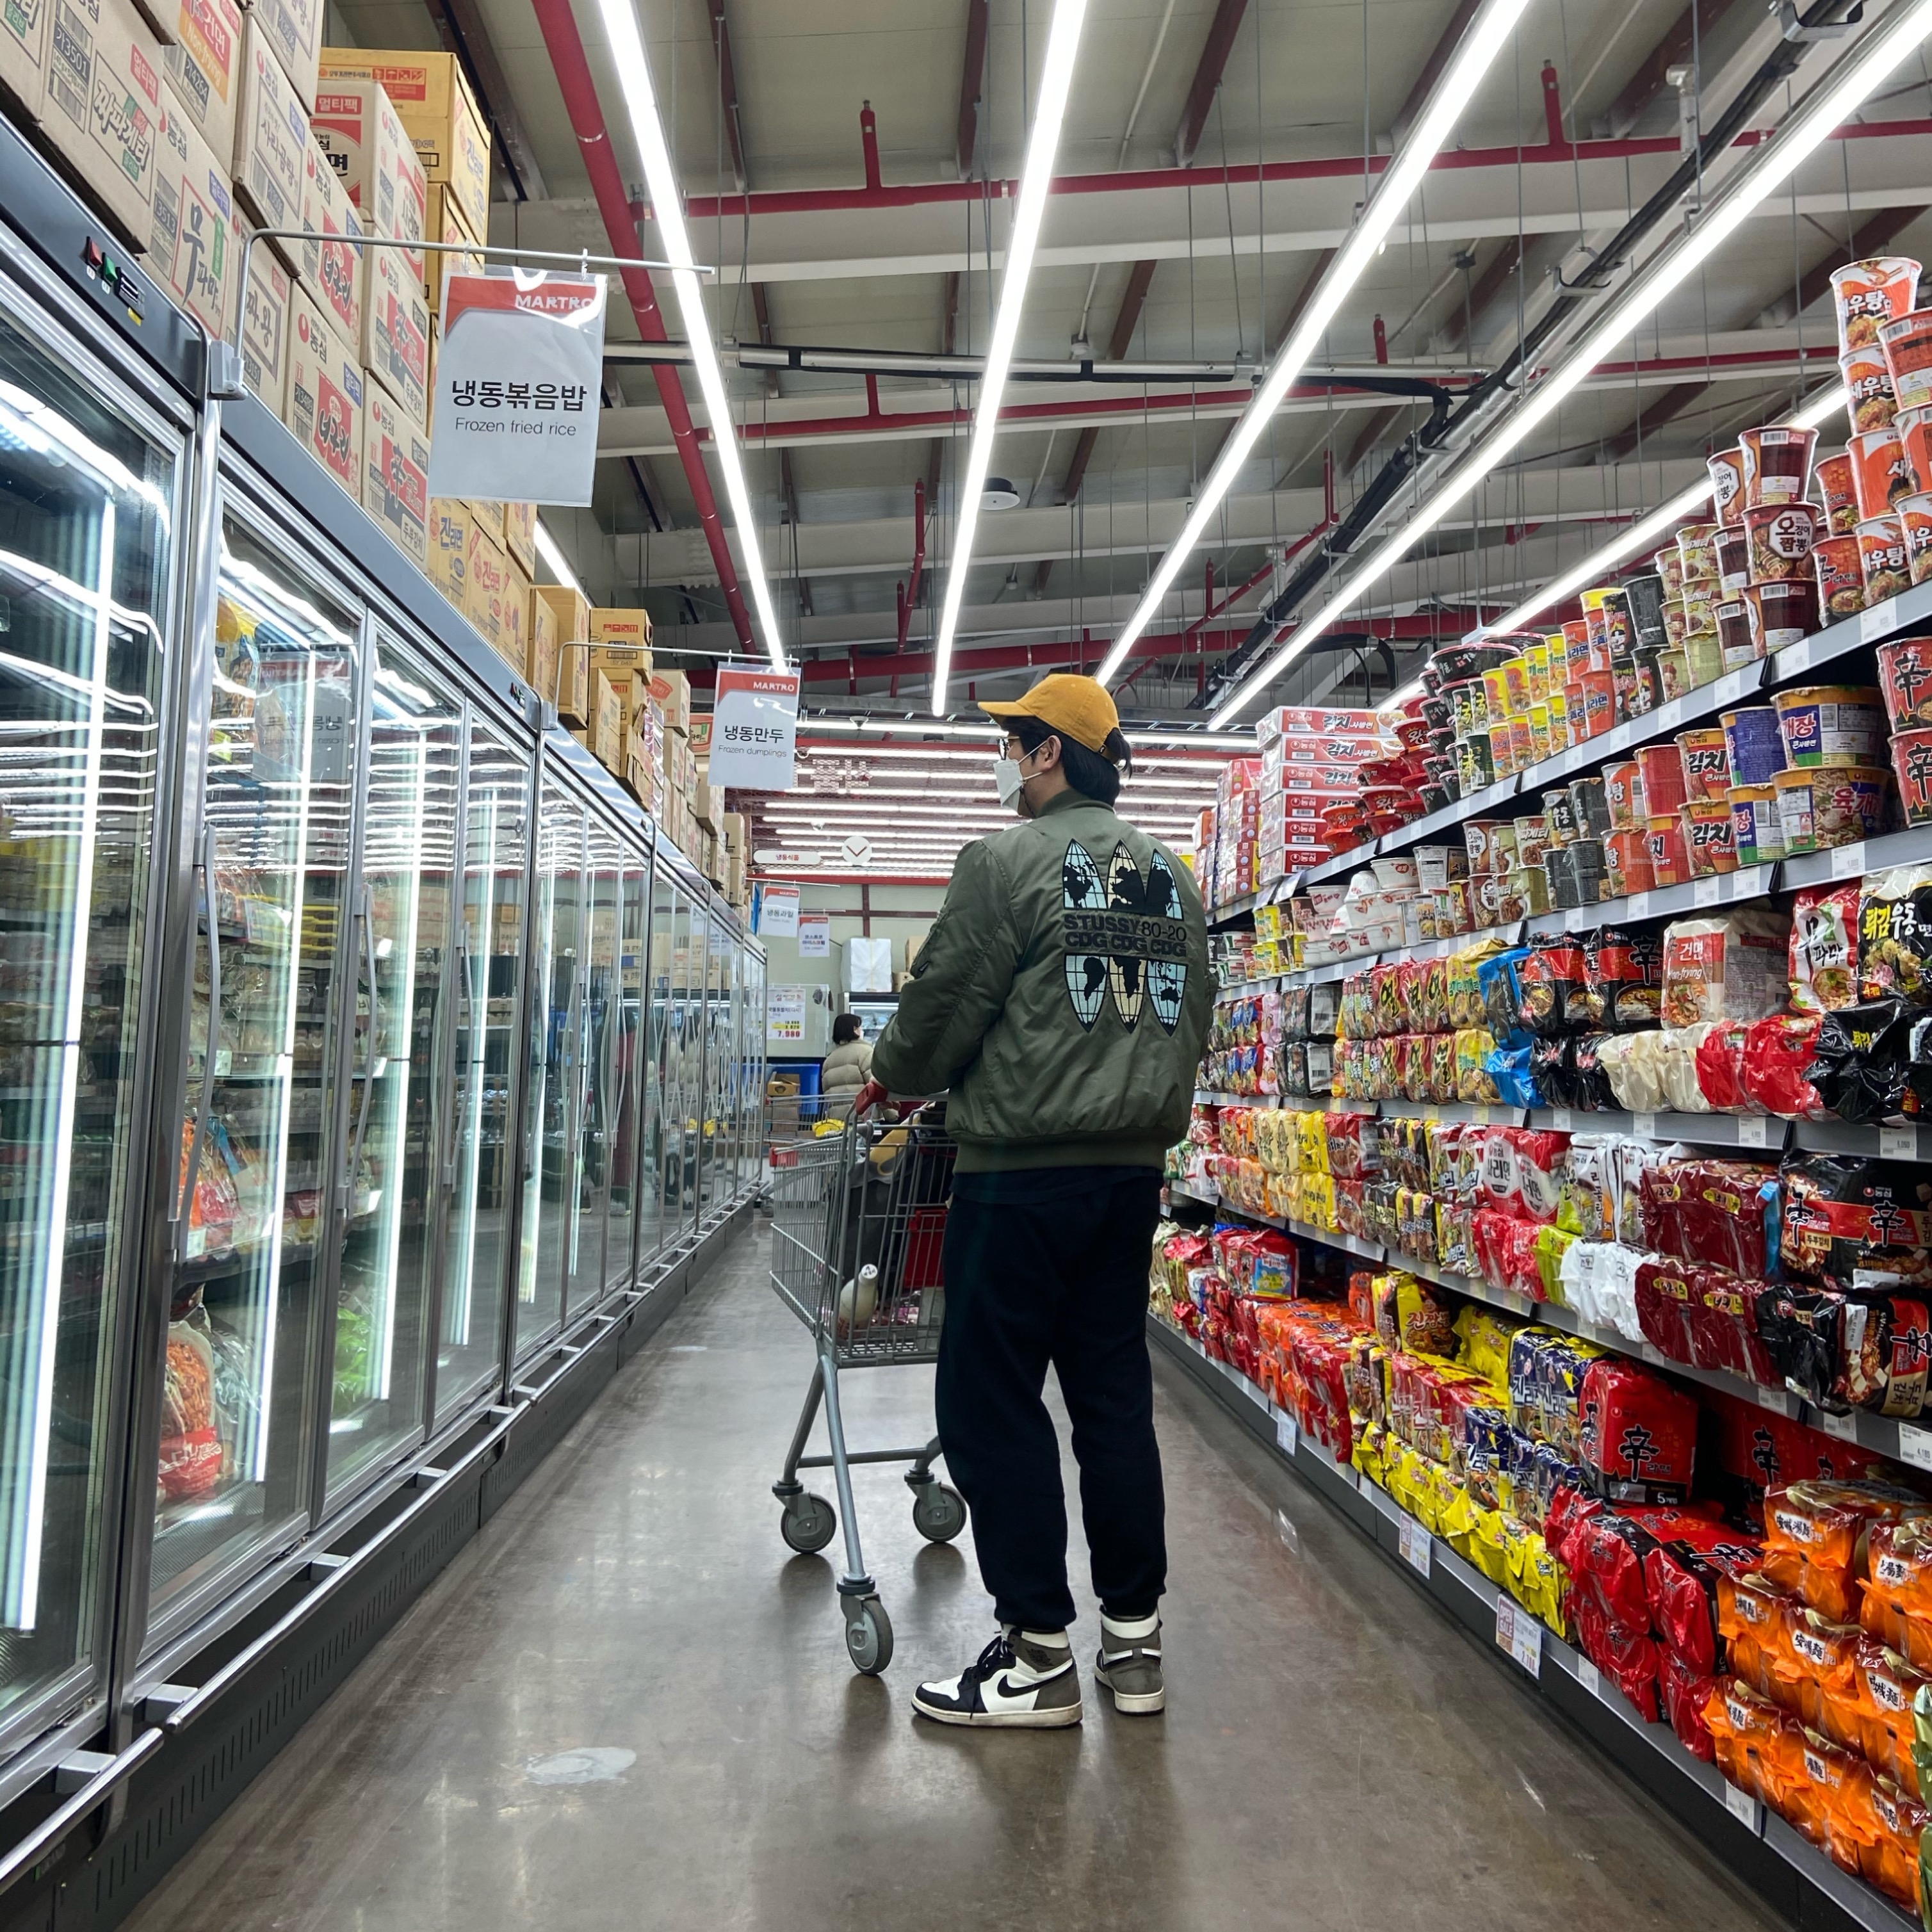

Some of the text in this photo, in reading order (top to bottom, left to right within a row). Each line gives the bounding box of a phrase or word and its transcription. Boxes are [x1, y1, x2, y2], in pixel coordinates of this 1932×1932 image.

[56, 27, 86, 77] 가3501
[133, 51, 156, 102] 멀티팩
[319, 97, 359, 113] 멀티팩
[93, 79, 150, 172] 짜파게티
[168, 119, 187, 162] 농심
[210, 177, 229, 221] 멀티팩
[156, 200, 177, 234] 3513
[323, 248, 352, 312] 너구리
[247, 290, 273, 348] 짜왕
[311, 329, 327, 364] 농심
[345, 367, 361, 406] 멀티팩
[452, 380, 587, 412] 냉동볶음밥
[319, 409, 350, 466] 너구리
[455, 417, 576, 436] Frozen fried rice
[1717, 472, 1732, 485] 징어
[440, 517, 463, 551] 진라면
[1775, 516, 1810, 536] 오징어
[1780, 536, 1808, 553] 짬뽕
[483, 561, 500, 594] 진라면
[753, 681, 795, 692] MARTRO
[1894, 651, 1932, 713] 辛
[1323, 715, 1351, 729] 김치
[1351, 721, 1374, 729] 사발면
[724, 725, 784, 744] 냉동만두
[1792, 739, 1817, 750] 큰사발면
[718, 745, 787, 758] Frozen dumplings
[1326, 743, 1356, 757] 김치
[1354, 749, 1378, 757] 사발면
[1687, 749, 1727, 775] 김치
[1324, 770, 1352, 786] 김치
[1552, 806, 1570, 827] 우동
[1301, 825, 1316, 833] 농심
[1692, 822, 1732, 847] 김치
[1301, 853, 1317, 862] 농심
[1652, 834, 1665, 858] 치
[767, 909, 794, 918] 냉동과일
[1863, 902, 1917, 941] 튀김우동
[1064, 914, 1187, 941] STUSSY 80-20
[1065, 932, 1187, 957] CDG CDG CDG
[1679, 939, 1704, 961] 건면
[1852, 1030, 1871, 1048] 튀김
[1488, 1158, 1511, 1181] 사리면
[1785, 1185, 1815, 1248] 辛
[1869, 1199, 1907, 1248] 辛
[1806, 1235, 1830, 1248] 두부김치
[1405, 1310, 1452, 1331] 진짬뽕
[1539, 1383, 1568, 1420] 진라면
[1618, 1424, 1660, 1483] 辛
[1499, 1603, 1513, 1623] OPEN
[1499, 1619, 1514, 1639] SALE
